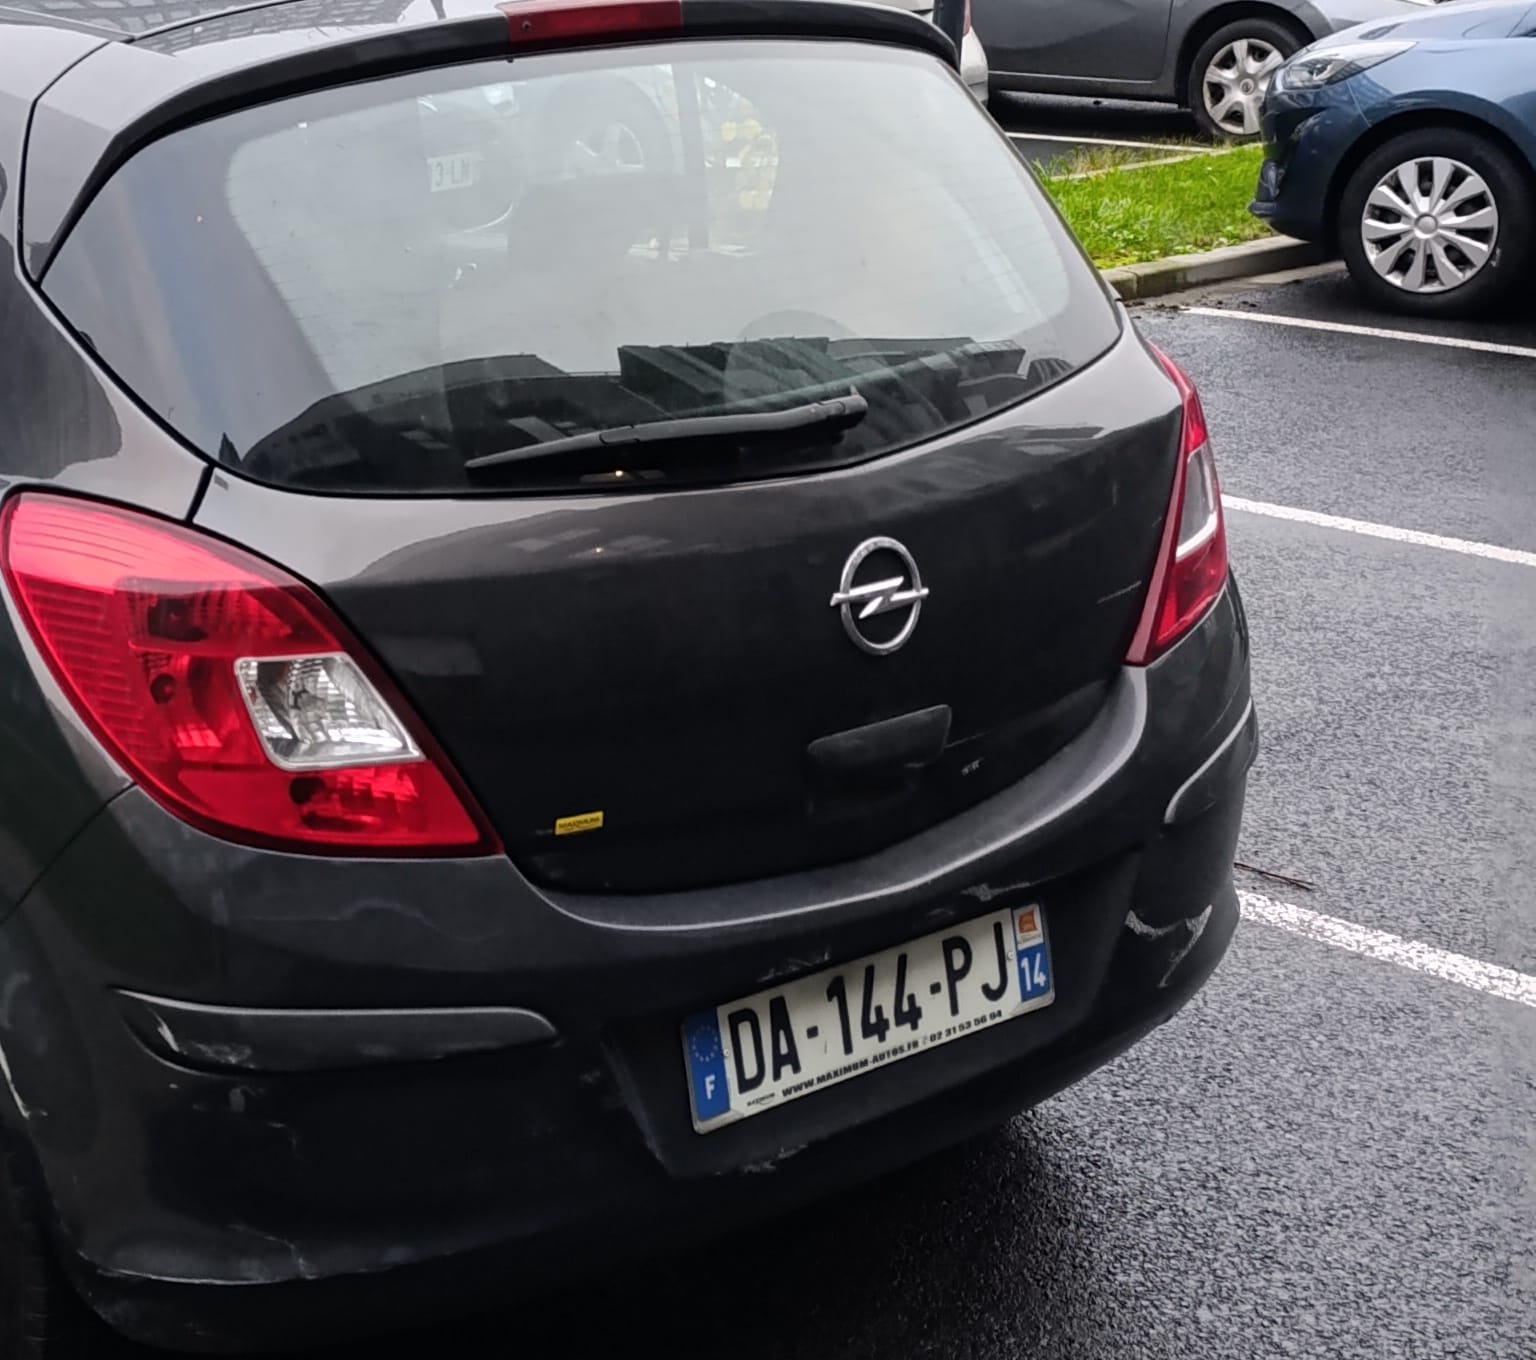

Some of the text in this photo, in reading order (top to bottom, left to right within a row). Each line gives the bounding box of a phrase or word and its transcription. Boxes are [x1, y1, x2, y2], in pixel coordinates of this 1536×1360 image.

[1020, 952, 1047, 992] 14
[727, 921, 1009, 1095] DA-144-PJ
[704, 1074, 716, 1100] F
